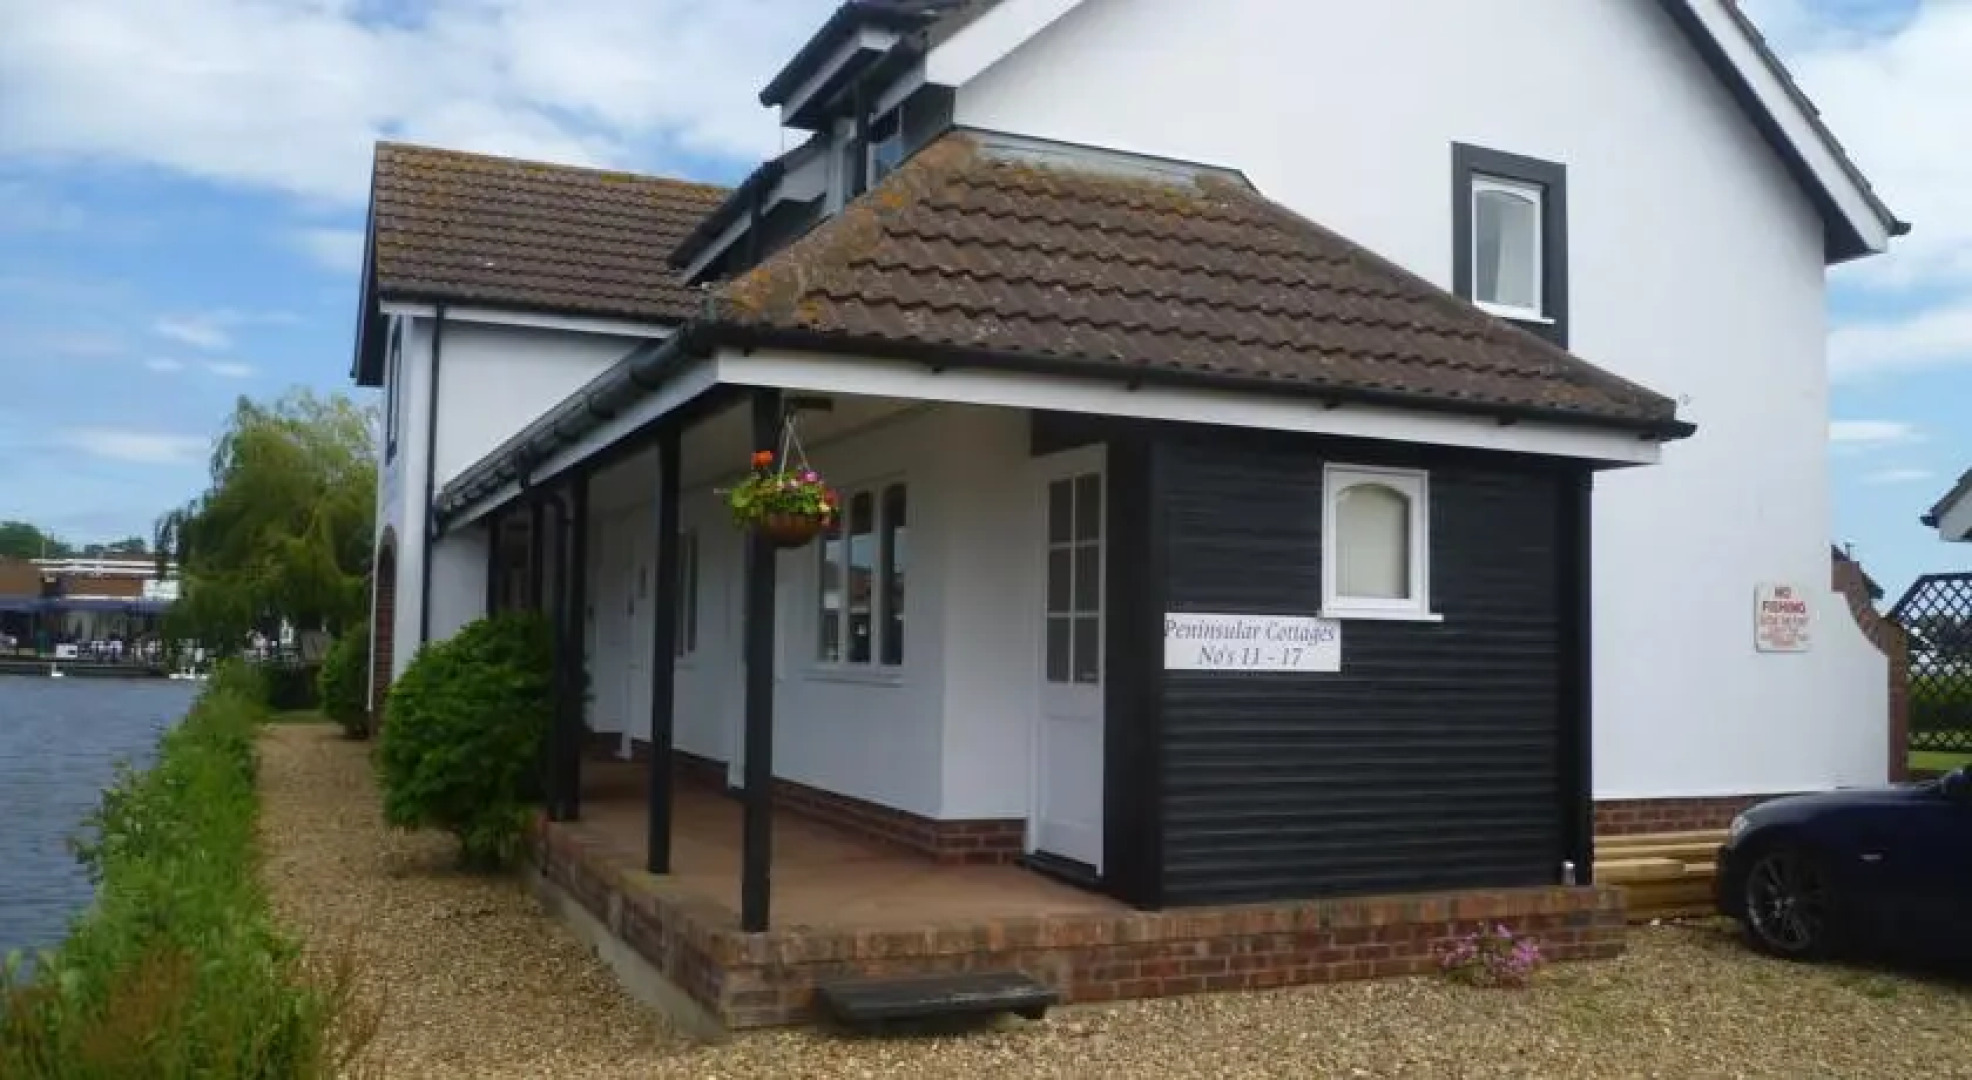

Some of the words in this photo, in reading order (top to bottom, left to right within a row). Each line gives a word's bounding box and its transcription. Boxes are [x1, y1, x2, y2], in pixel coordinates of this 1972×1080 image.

[1165, 619, 1261, 639] Peninsular
[1265, 621, 1335, 646] Cottages
[1241, 647, 1260, 665] 11
[1282, 648, 1304, 666] 17
